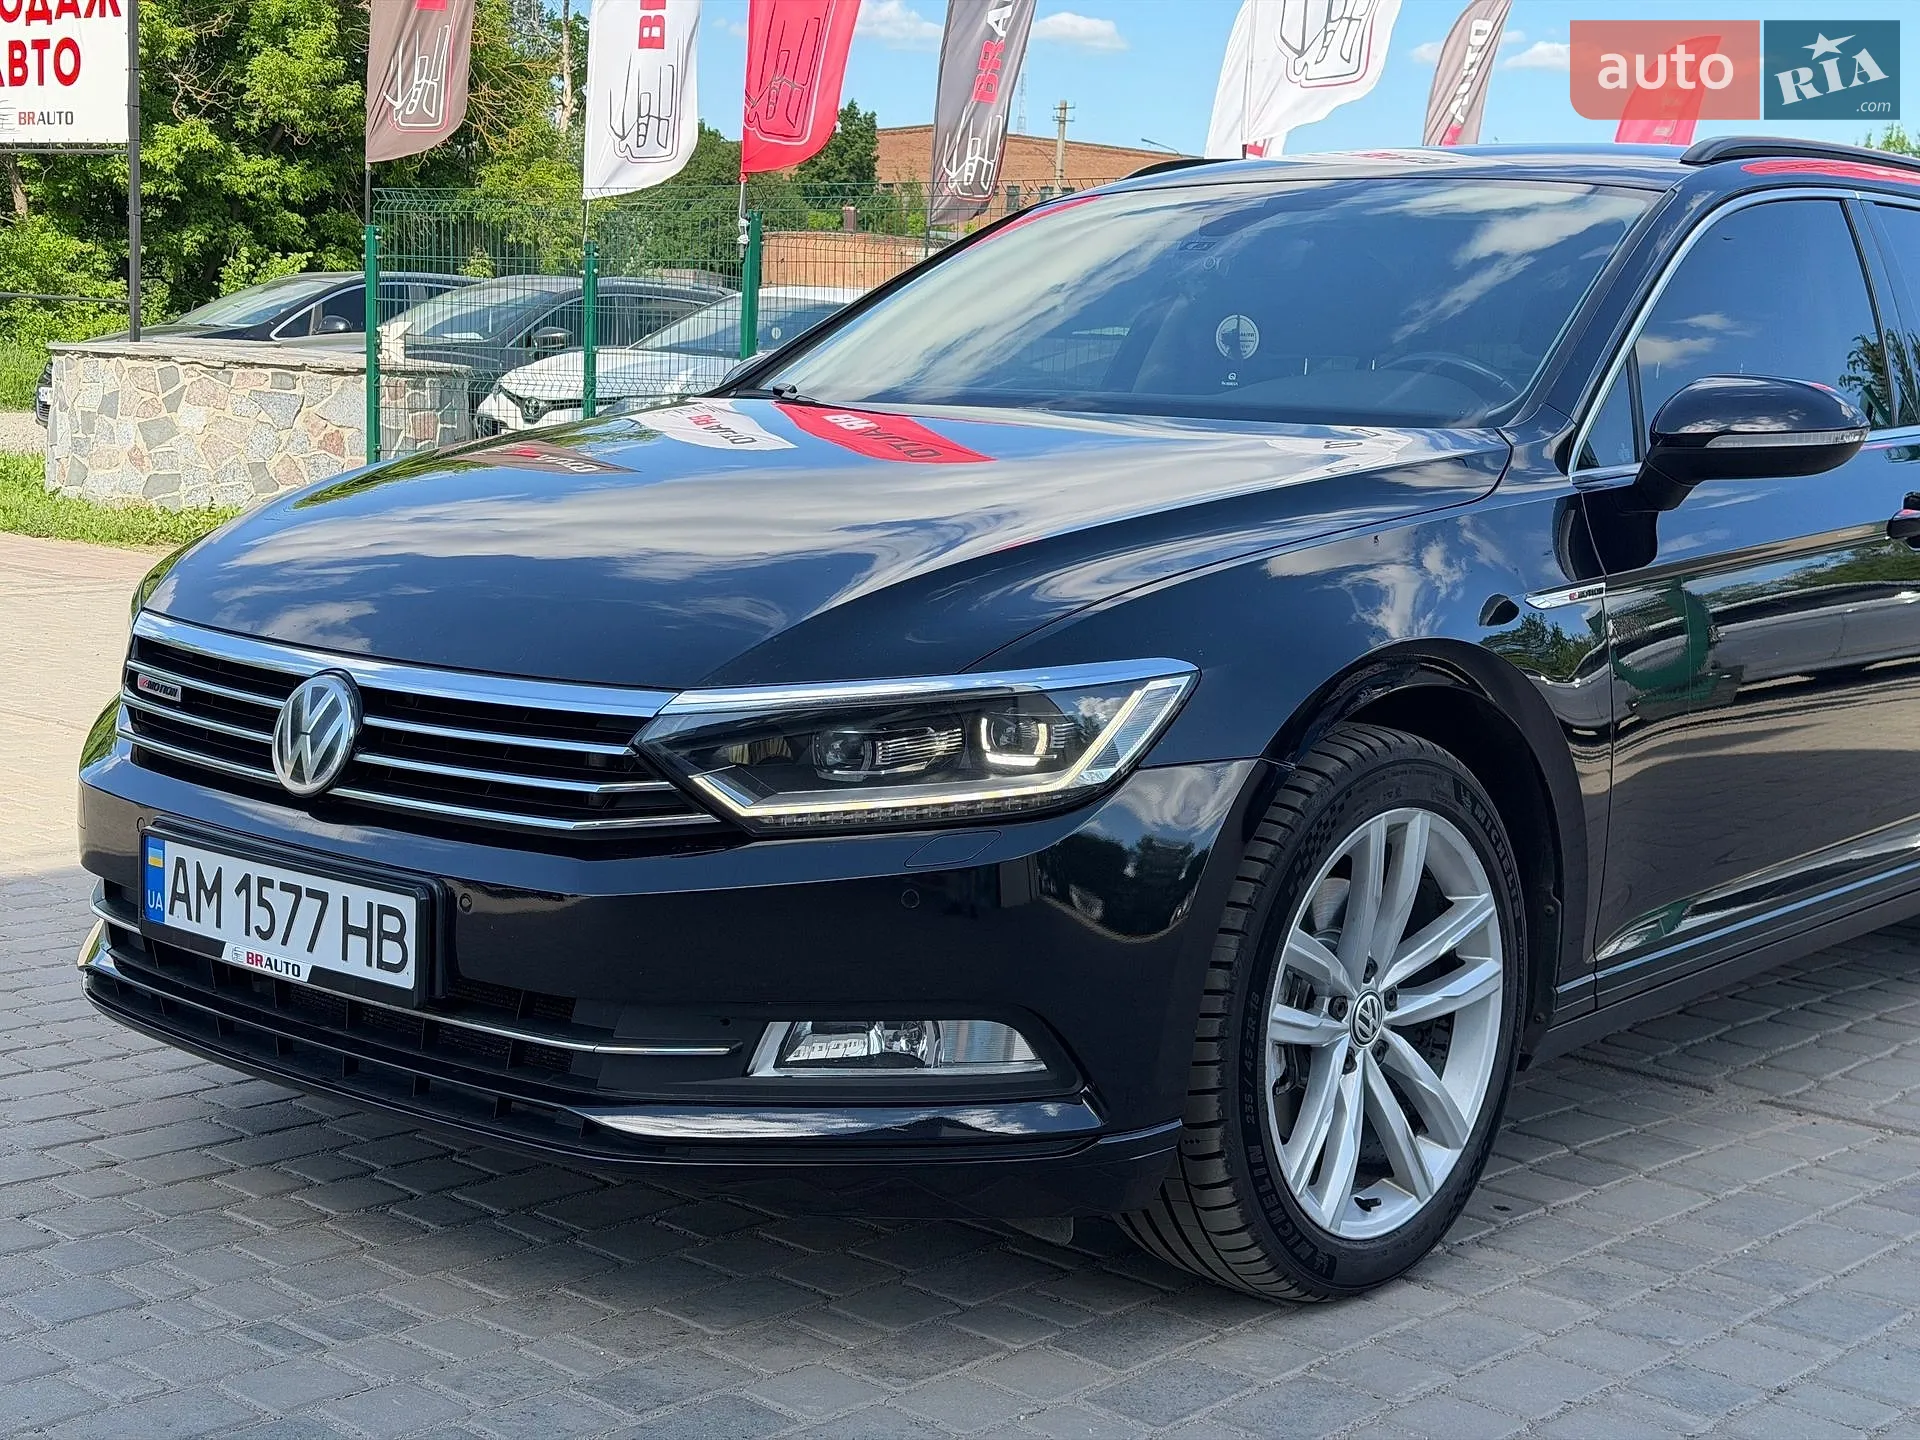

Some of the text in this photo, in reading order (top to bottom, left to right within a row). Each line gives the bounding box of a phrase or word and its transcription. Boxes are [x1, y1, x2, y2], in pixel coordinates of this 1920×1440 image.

[638, 0, 666, 49] B
[0, 37, 81, 87] ВТО
[18, 111, 74, 126] BRAUTO
[147, 889, 163, 912] UA
[168, 856, 409, 974] AM 1577 HB
[246, 951, 301, 978] BRAUTO
